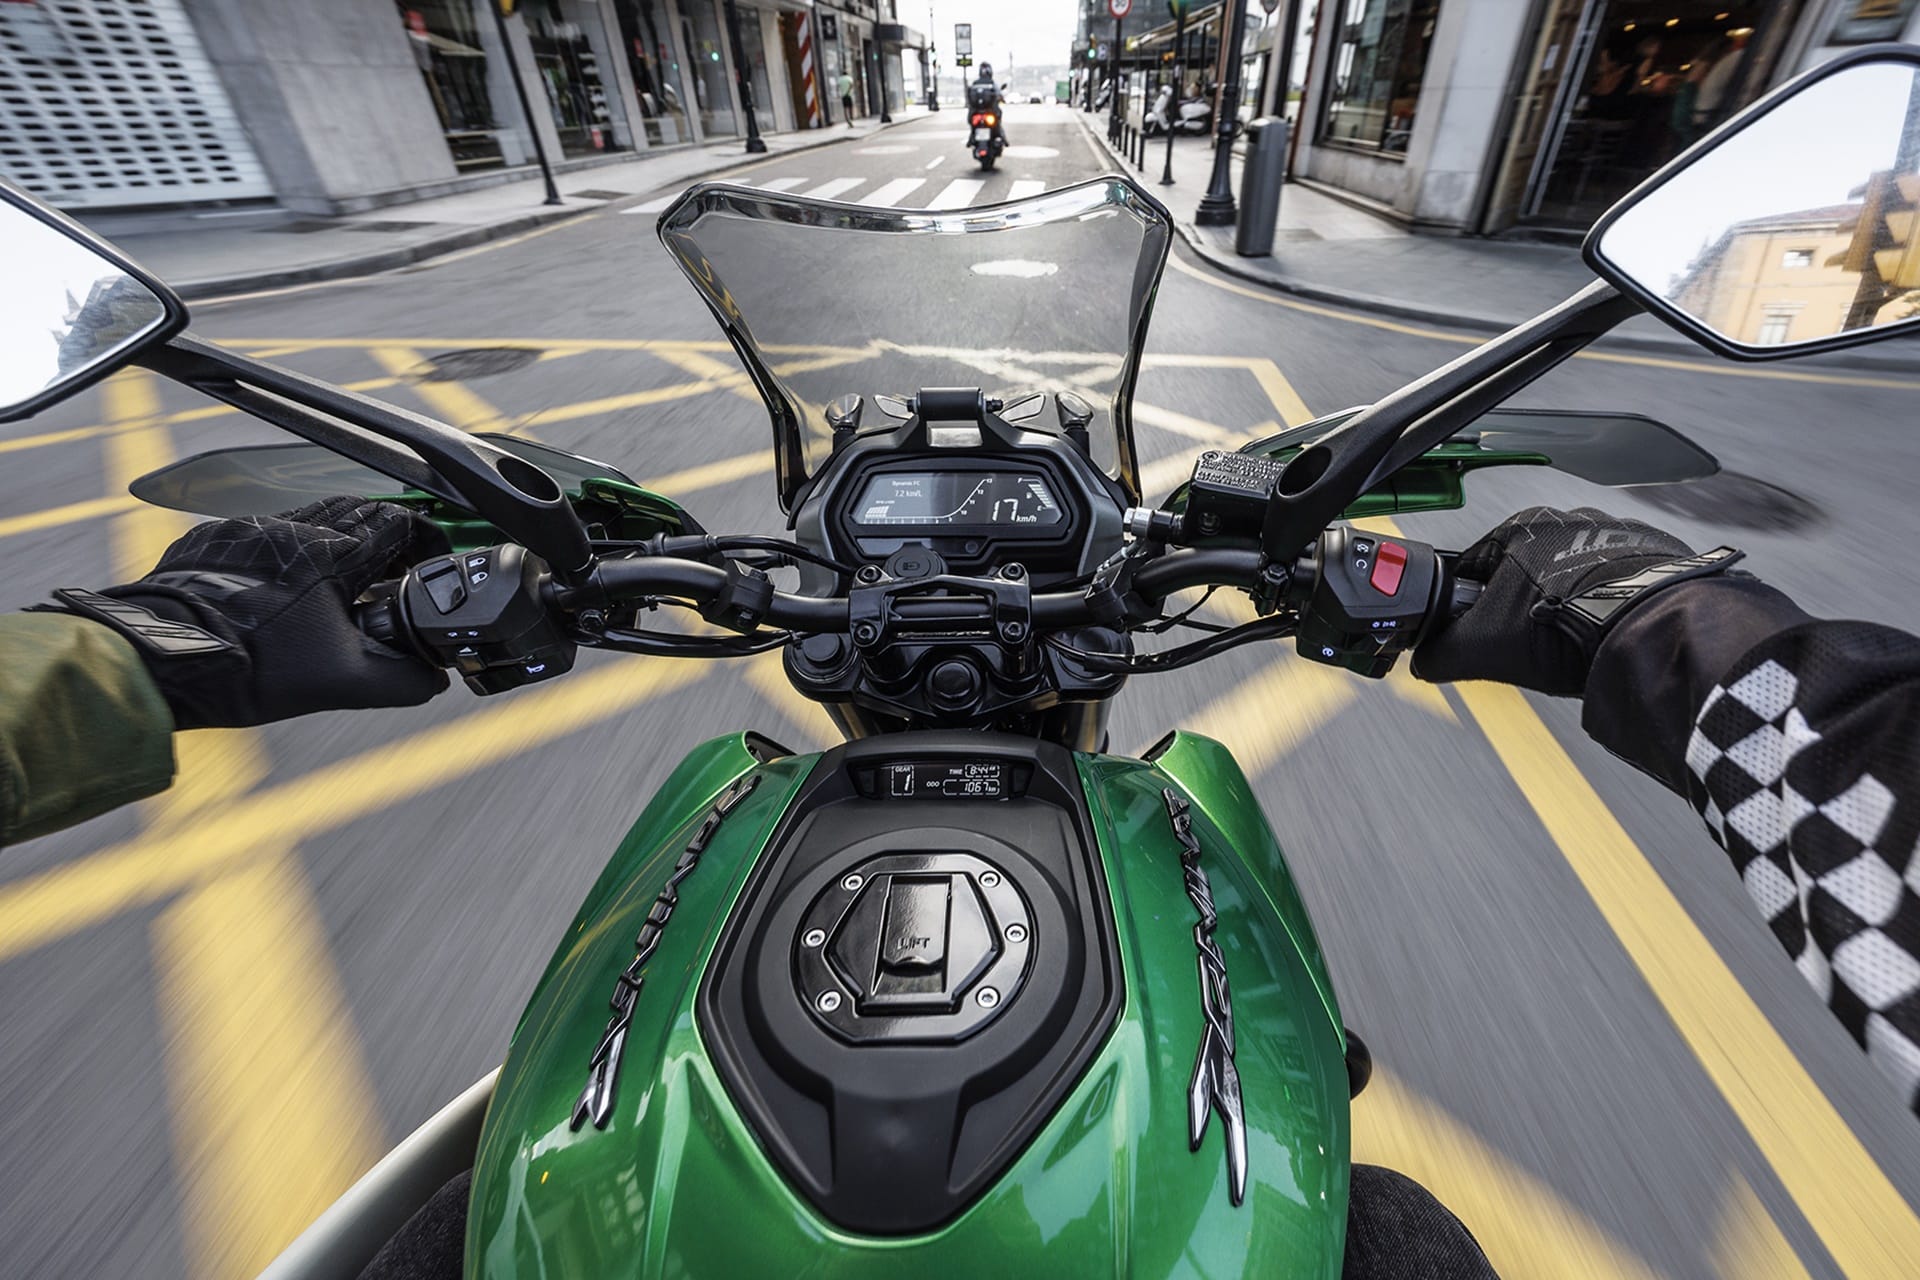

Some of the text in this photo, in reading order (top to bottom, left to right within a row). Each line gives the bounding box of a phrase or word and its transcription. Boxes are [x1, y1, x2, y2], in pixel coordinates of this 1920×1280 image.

[992, 498, 1037, 522] 17 km/h
[895, 765, 911, 773] GEAR
[970, 766, 988, 775] 8:44
[904, 774, 911, 791] 1
[965, 781, 989, 792] 1067
[897, 937, 930, 950] LIFT
